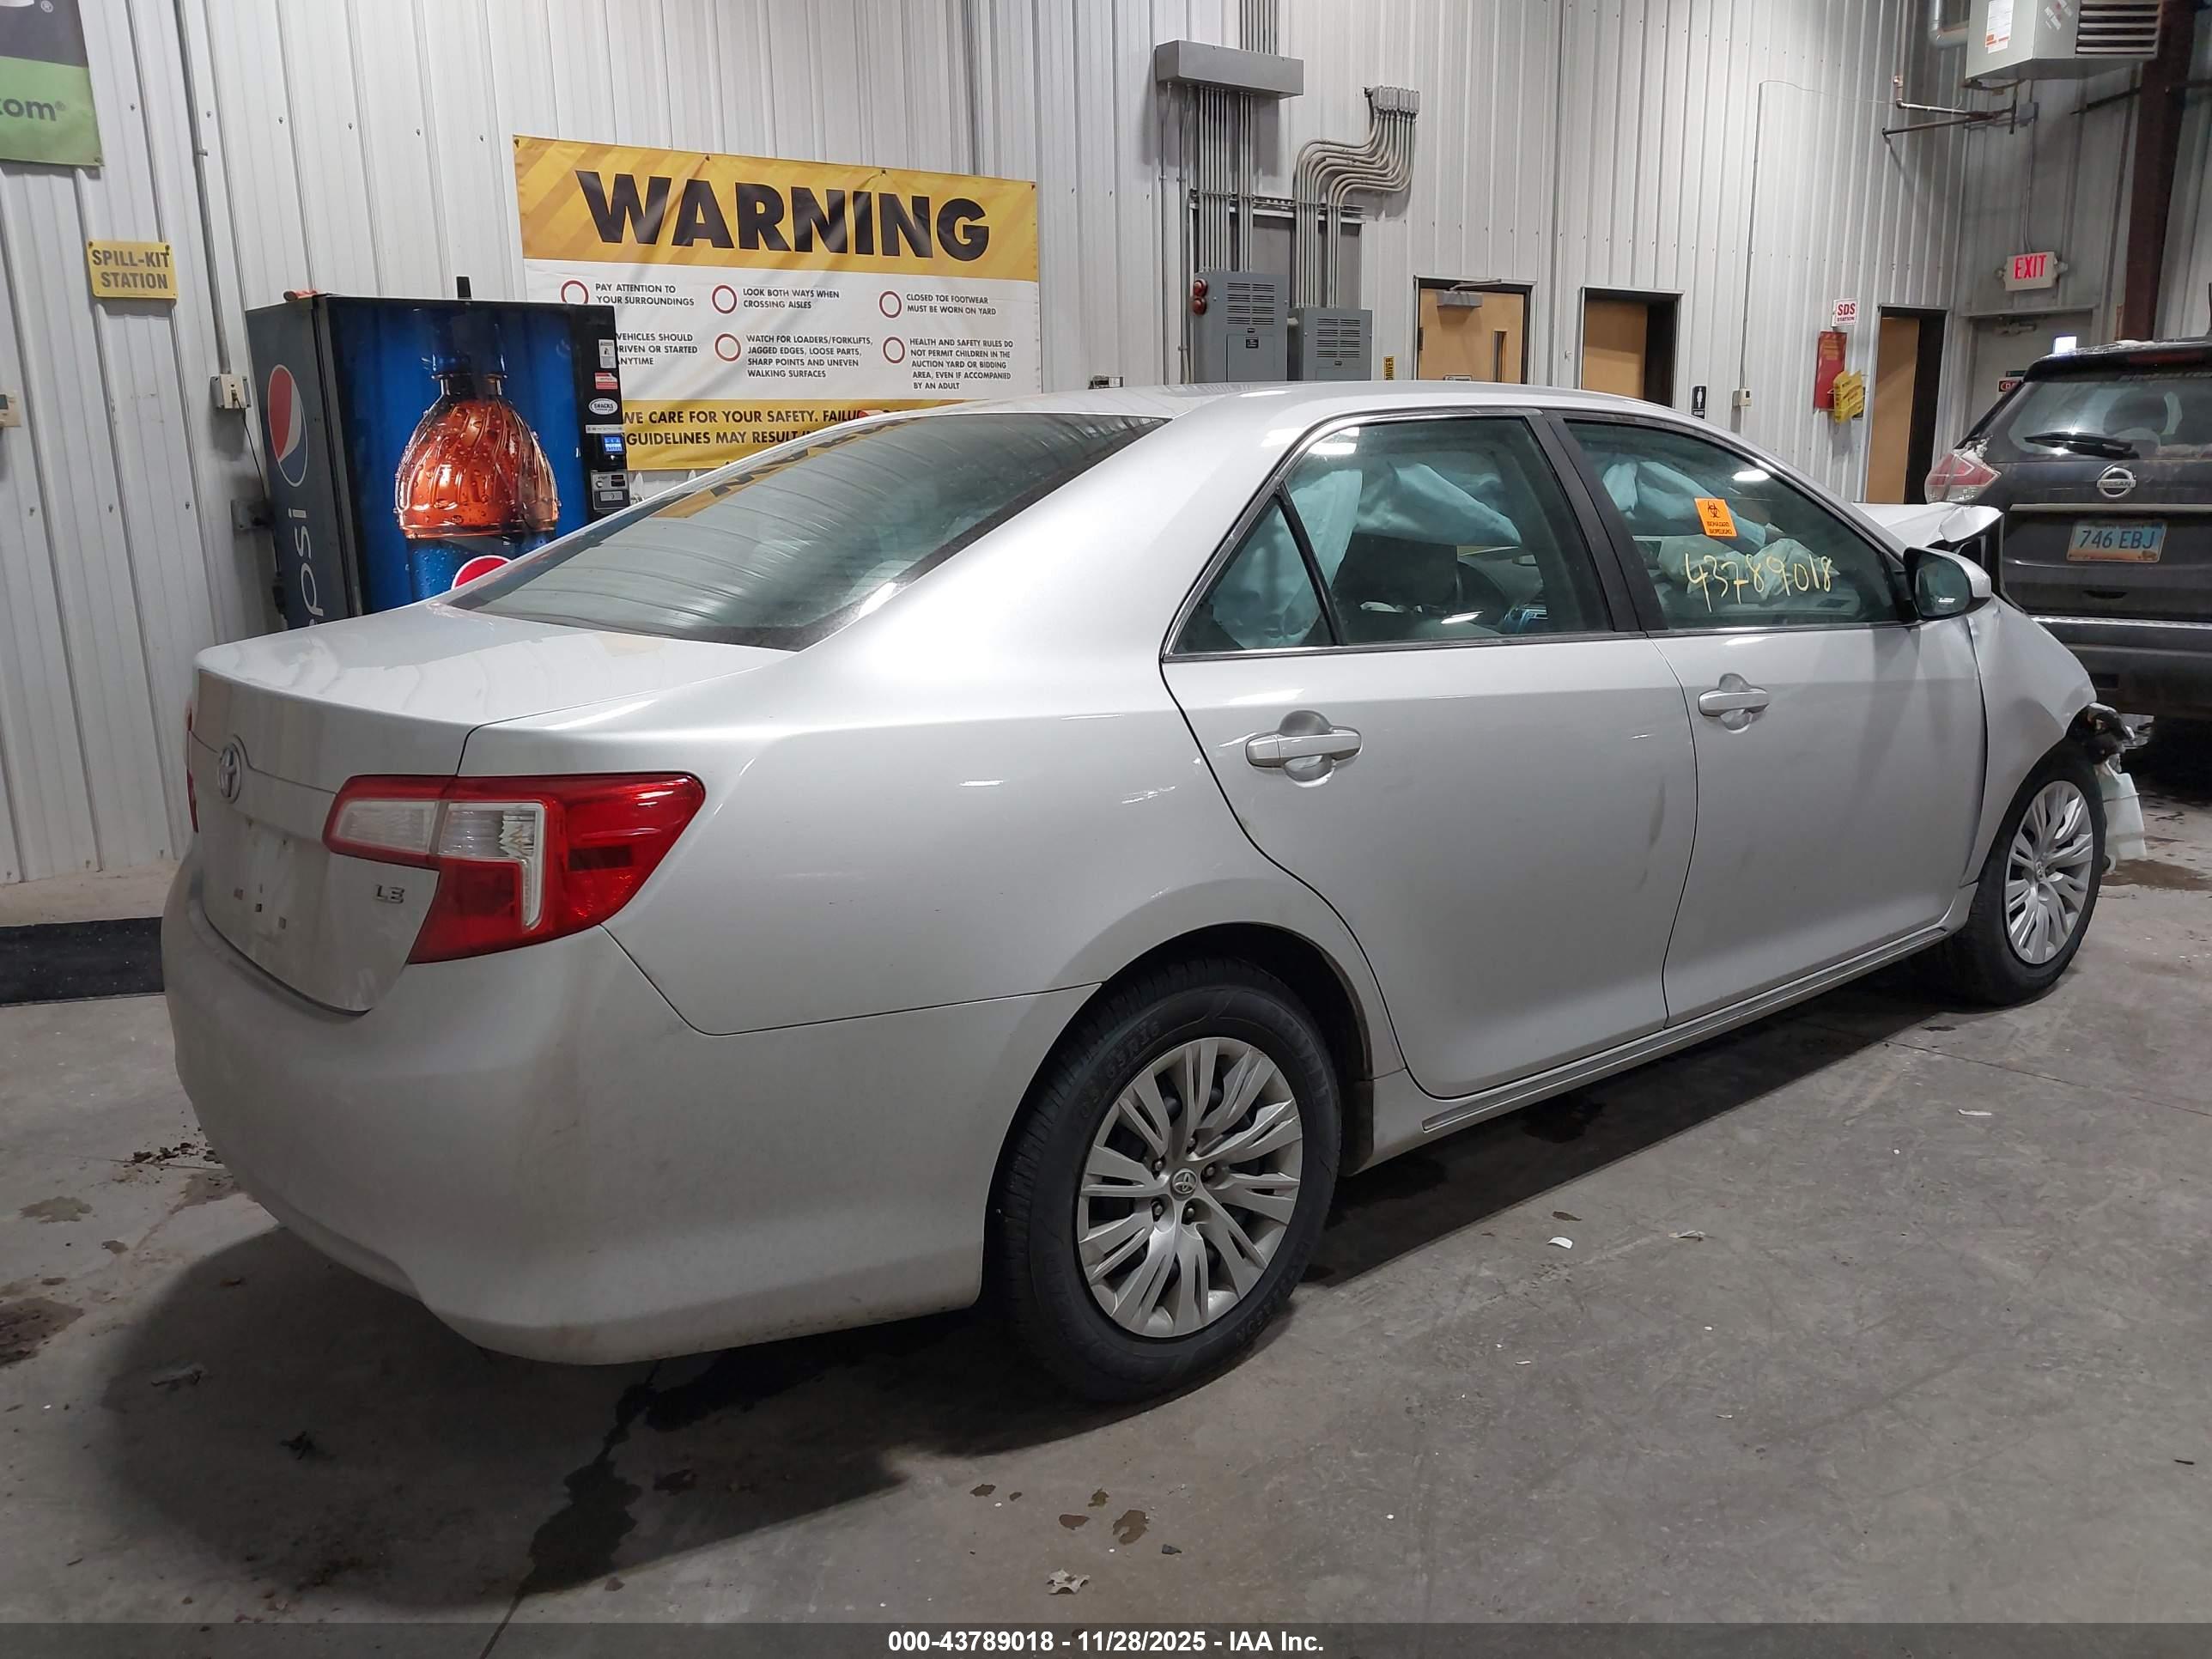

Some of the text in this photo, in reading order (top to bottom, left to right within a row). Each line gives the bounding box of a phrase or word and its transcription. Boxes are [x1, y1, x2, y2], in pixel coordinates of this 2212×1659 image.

[576, 170, 989, 261] WARNING
[92, 249, 169, 268] SPILL-KIT
[2014, 255, 2047, 280] EXIT
[101, 271, 167, 289] STATION
[595, 283, 676, 294] PAY ATTENTION TO
[743, 288, 765, 296] LOOK
[768, 289, 789, 297] BOTH
[792, 289, 815, 298] WAYS
[596, 295, 695, 306] YOUR SURROUNDINGS
[951, 295, 988, 304] FOOTWEAR
[1838, 303, 1856, 316] SDS
[659, 333, 693, 342] SHOULD
[793, 336, 873, 345] LOADERS/FORKLIFTS,
[780, 347, 807, 356] EDGES,
[836, 348, 862, 356] PARTS,
[912, 371, 933, 380] AREA,
[648, 410, 684, 424] CARE
[689, 410, 716, 423] FOR
[722, 410, 763, 423] YOUR
[767, 410, 818, 422] SAFETY.
[823, 410, 862, 422] FAILU
[626, 432, 710, 446] GUIDELINES
[715, 431, 746, 445] MAY
[752, 430, 799, 444] RESULT
[2100, 480, 2132, 489] NISSAN
[2079, 530, 2155, 550] 746 EBJ
[1685, 553, 1832, 613] 43789018
[375, 884, 405, 904] LE
